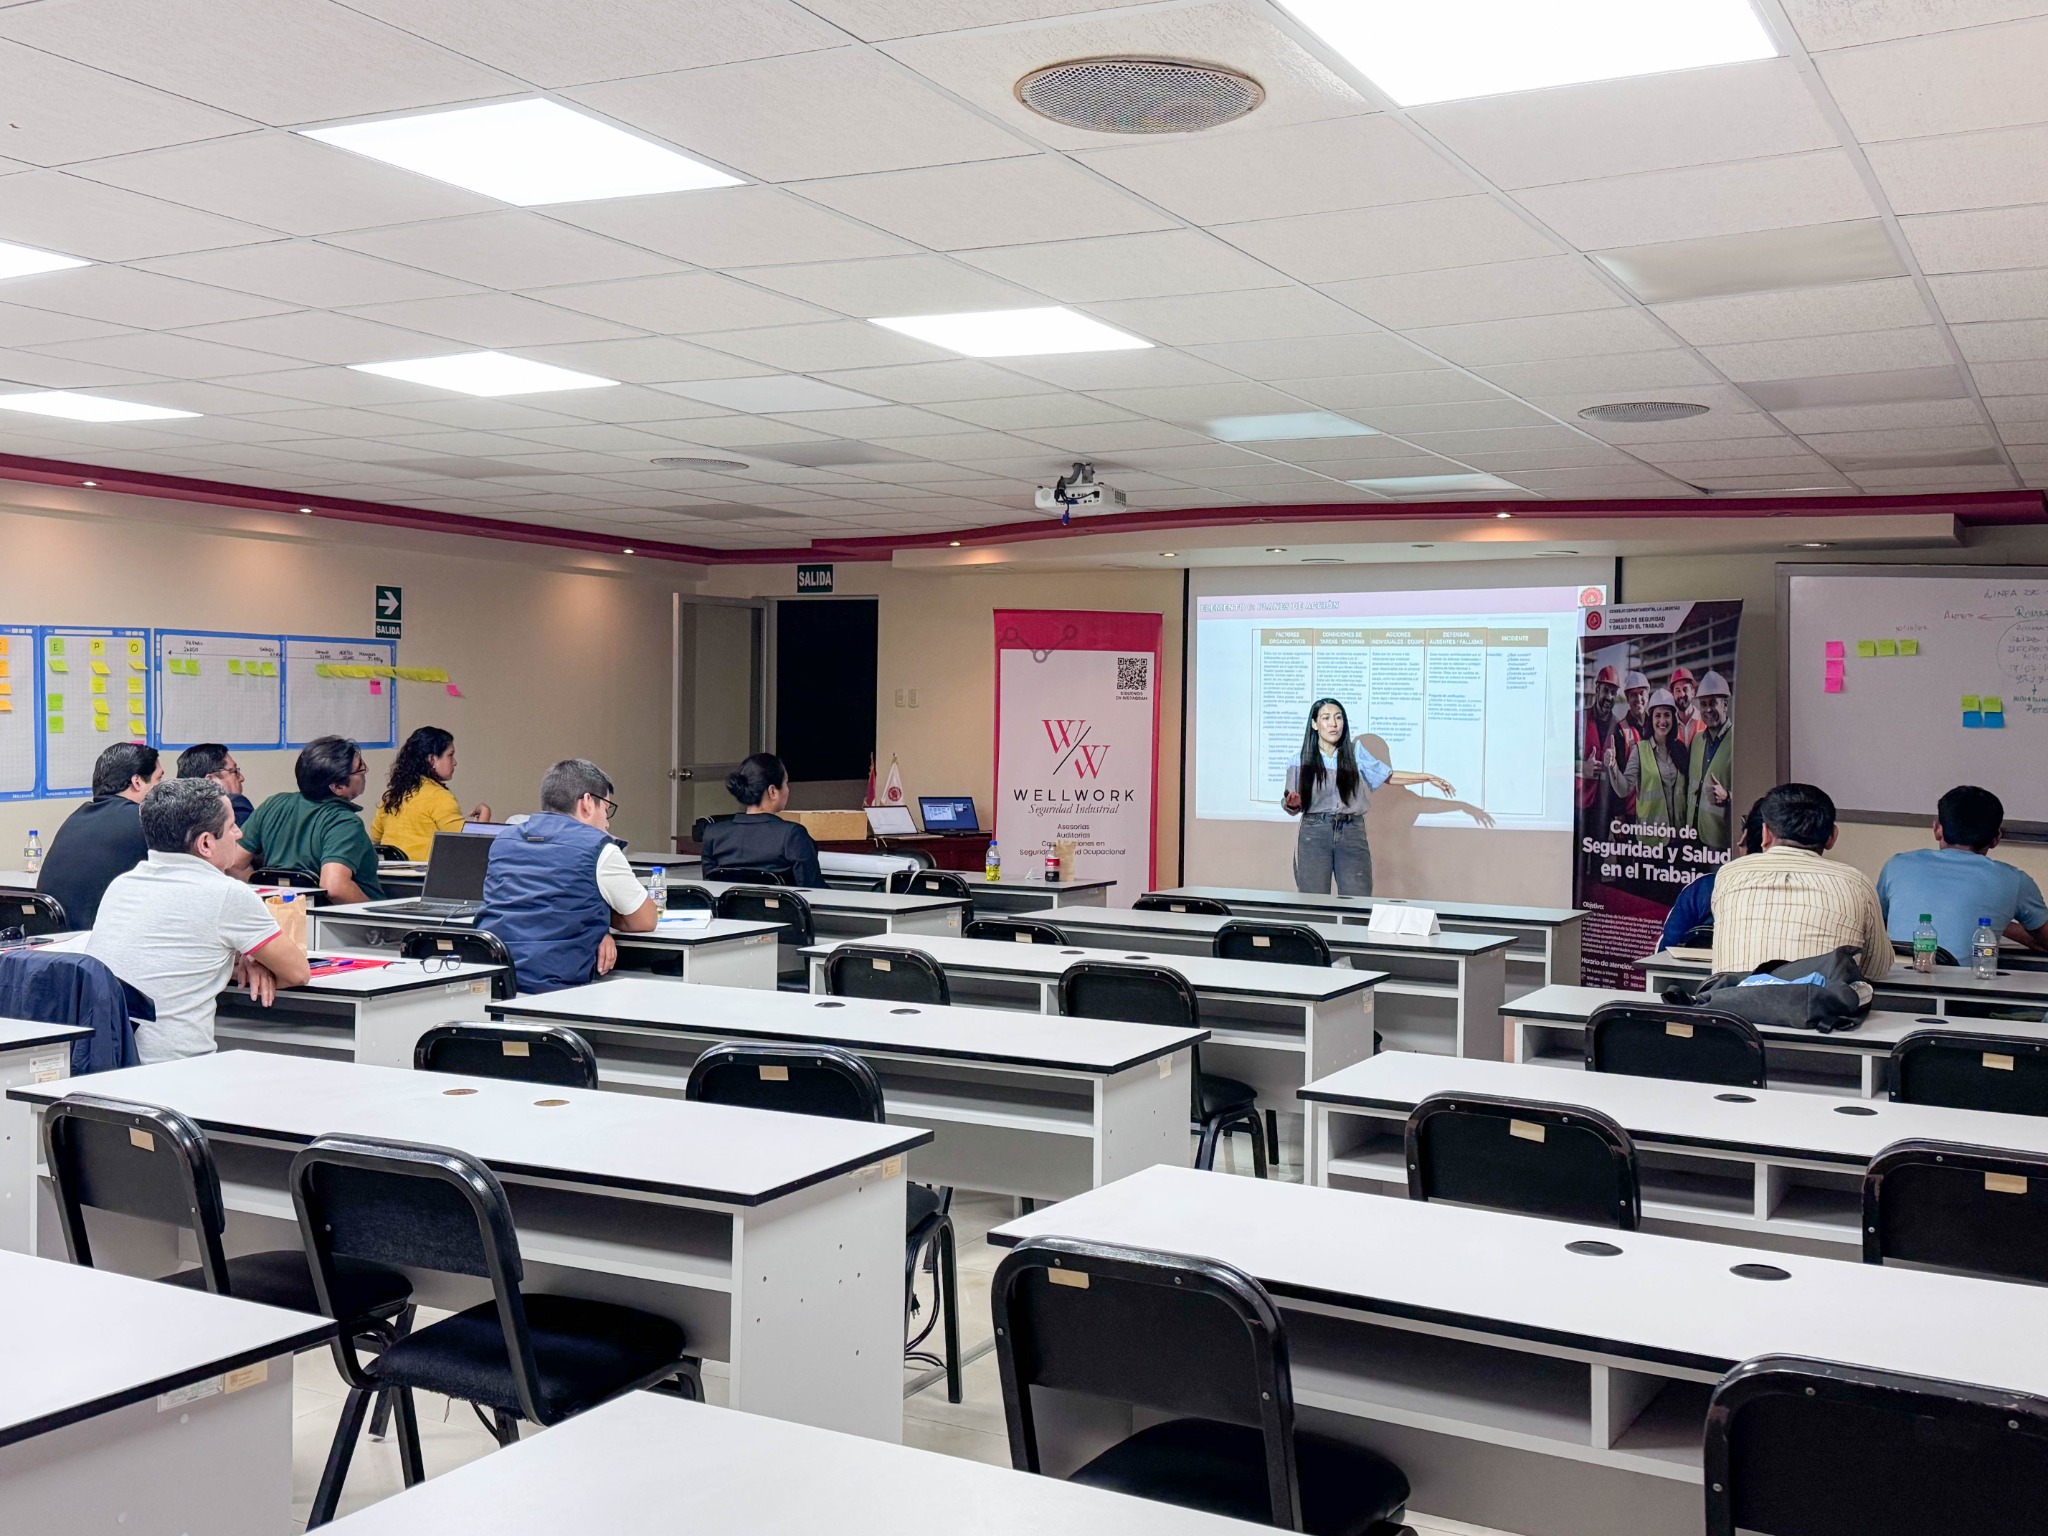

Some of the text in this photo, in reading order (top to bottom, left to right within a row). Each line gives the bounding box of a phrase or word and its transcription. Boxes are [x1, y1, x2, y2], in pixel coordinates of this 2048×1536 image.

[799, 571, 832, 586] SALIDA
[1200, 604, 1245, 612] ELEMENTO
[1292, 602, 1303, 610] DE
[1305, 600, 1340, 609] ACCIÓN
[376, 625, 400, 635] SALIDA
[53, 643, 59, 651] E
[1014, 789, 1134, 801] WELLWORK
[1028, 804, 1120, 817] Seguridad Industrial
[1610, 820, 1697, 839] Comisión de
[1582, 837, 1731, 865] Seguridad y Salud
[1601, 863, 1622, 877] en
[1625, 862, 1639, 879] el
[1582, 957, 1600, 966] Horario
